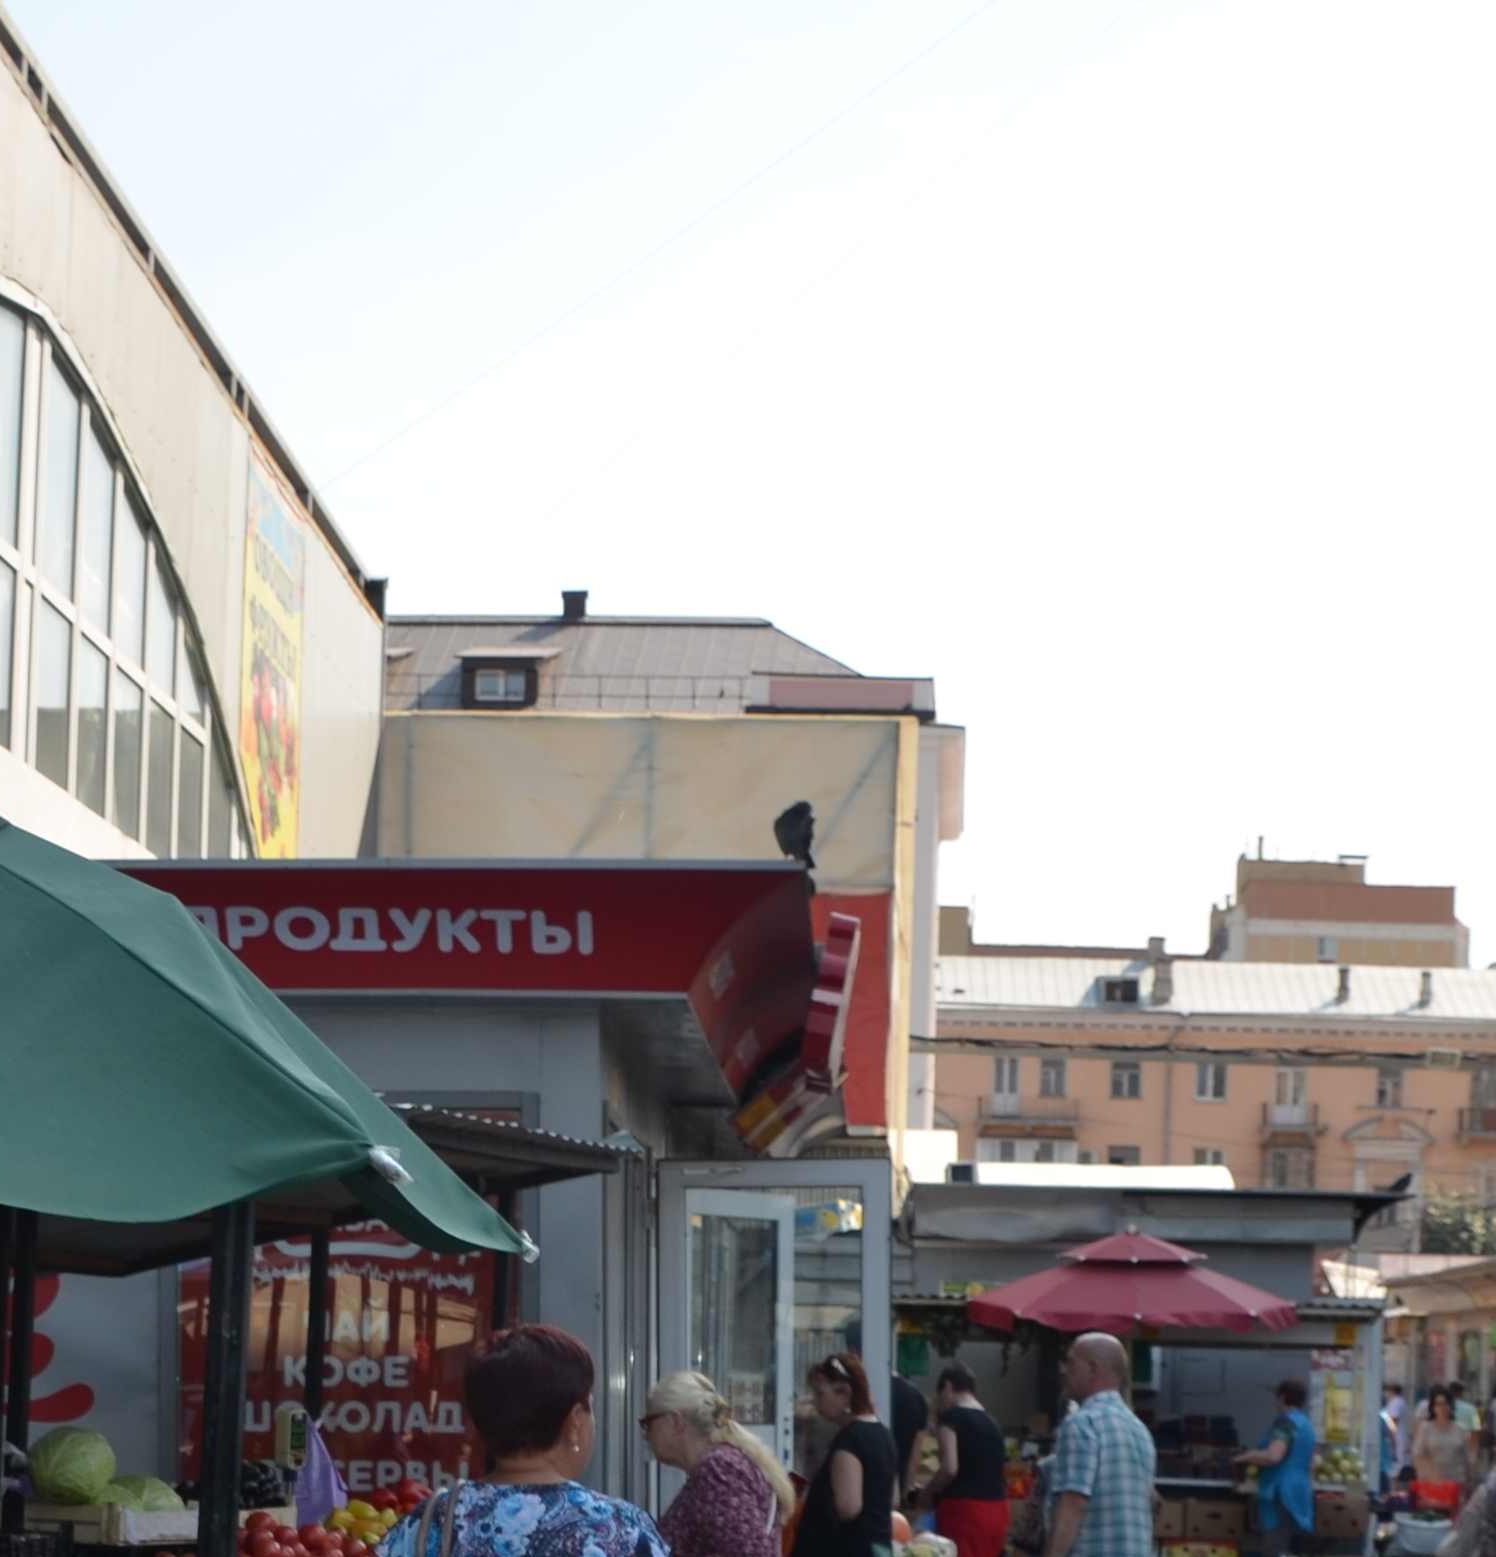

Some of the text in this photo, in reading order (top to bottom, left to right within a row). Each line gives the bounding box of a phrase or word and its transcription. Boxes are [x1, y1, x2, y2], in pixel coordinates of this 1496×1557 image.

[324, 1299, 391, 1344] АЙ
[282, 1355, 410, 1389] КОФЕ
[243, 1400, 465, 1434] ШКОЛАД
